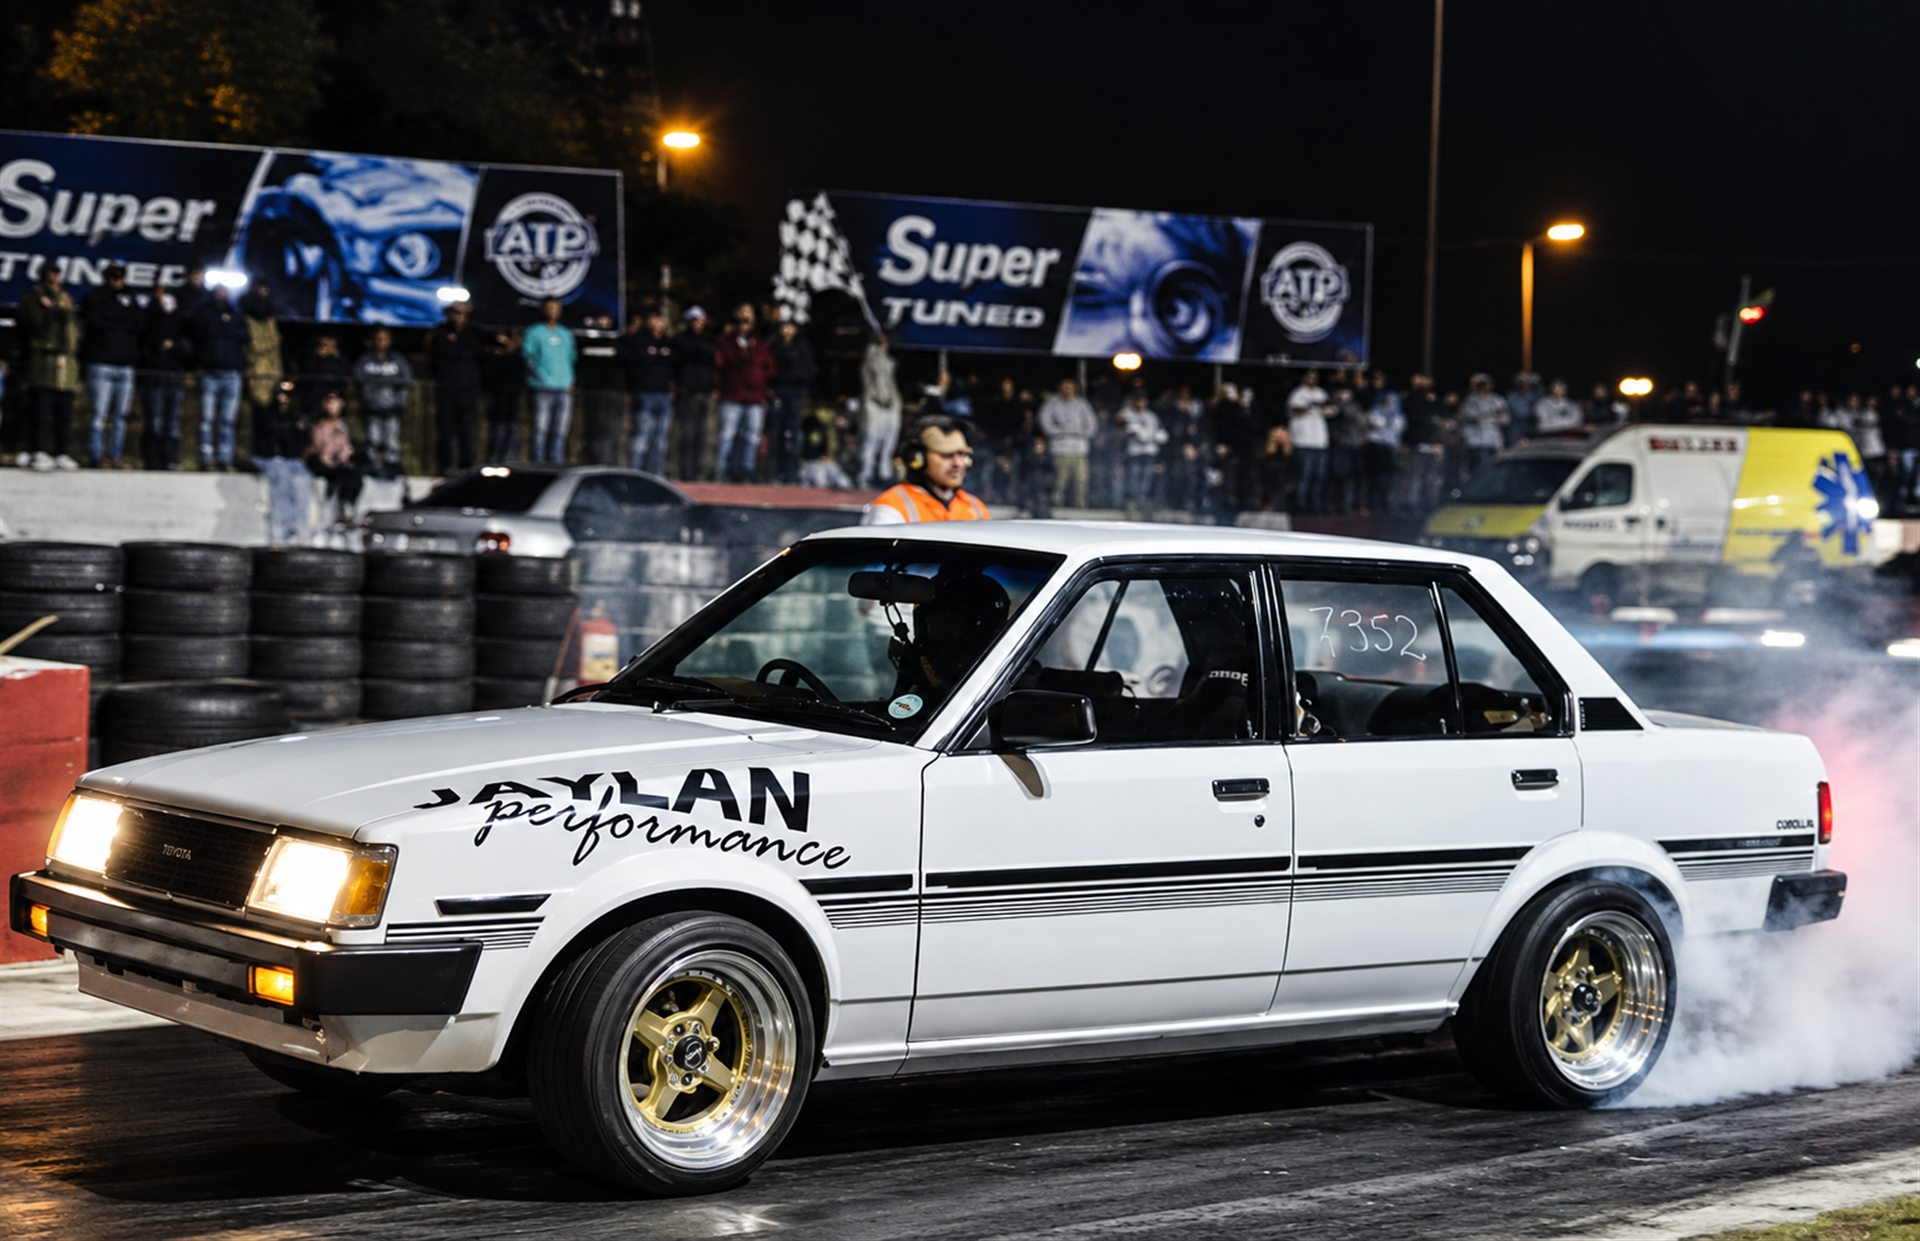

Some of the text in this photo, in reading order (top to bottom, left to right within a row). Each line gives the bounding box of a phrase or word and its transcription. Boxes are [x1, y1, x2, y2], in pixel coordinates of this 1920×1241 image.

[0, 158, 217, 247] Super
[499, 221, 588, 260] ATP
[878, 214, 1062, 290] Super
[1272, 267, 1342, 304] ATP
[882, 297, 1046, 330] TUNED
[1308, 606, 1428, 661] 7352
[412, 767, 811, 834] JAYLAN
[473, 784, 852, 871] performance
[162, 843, 192, 861] TOYOTA
